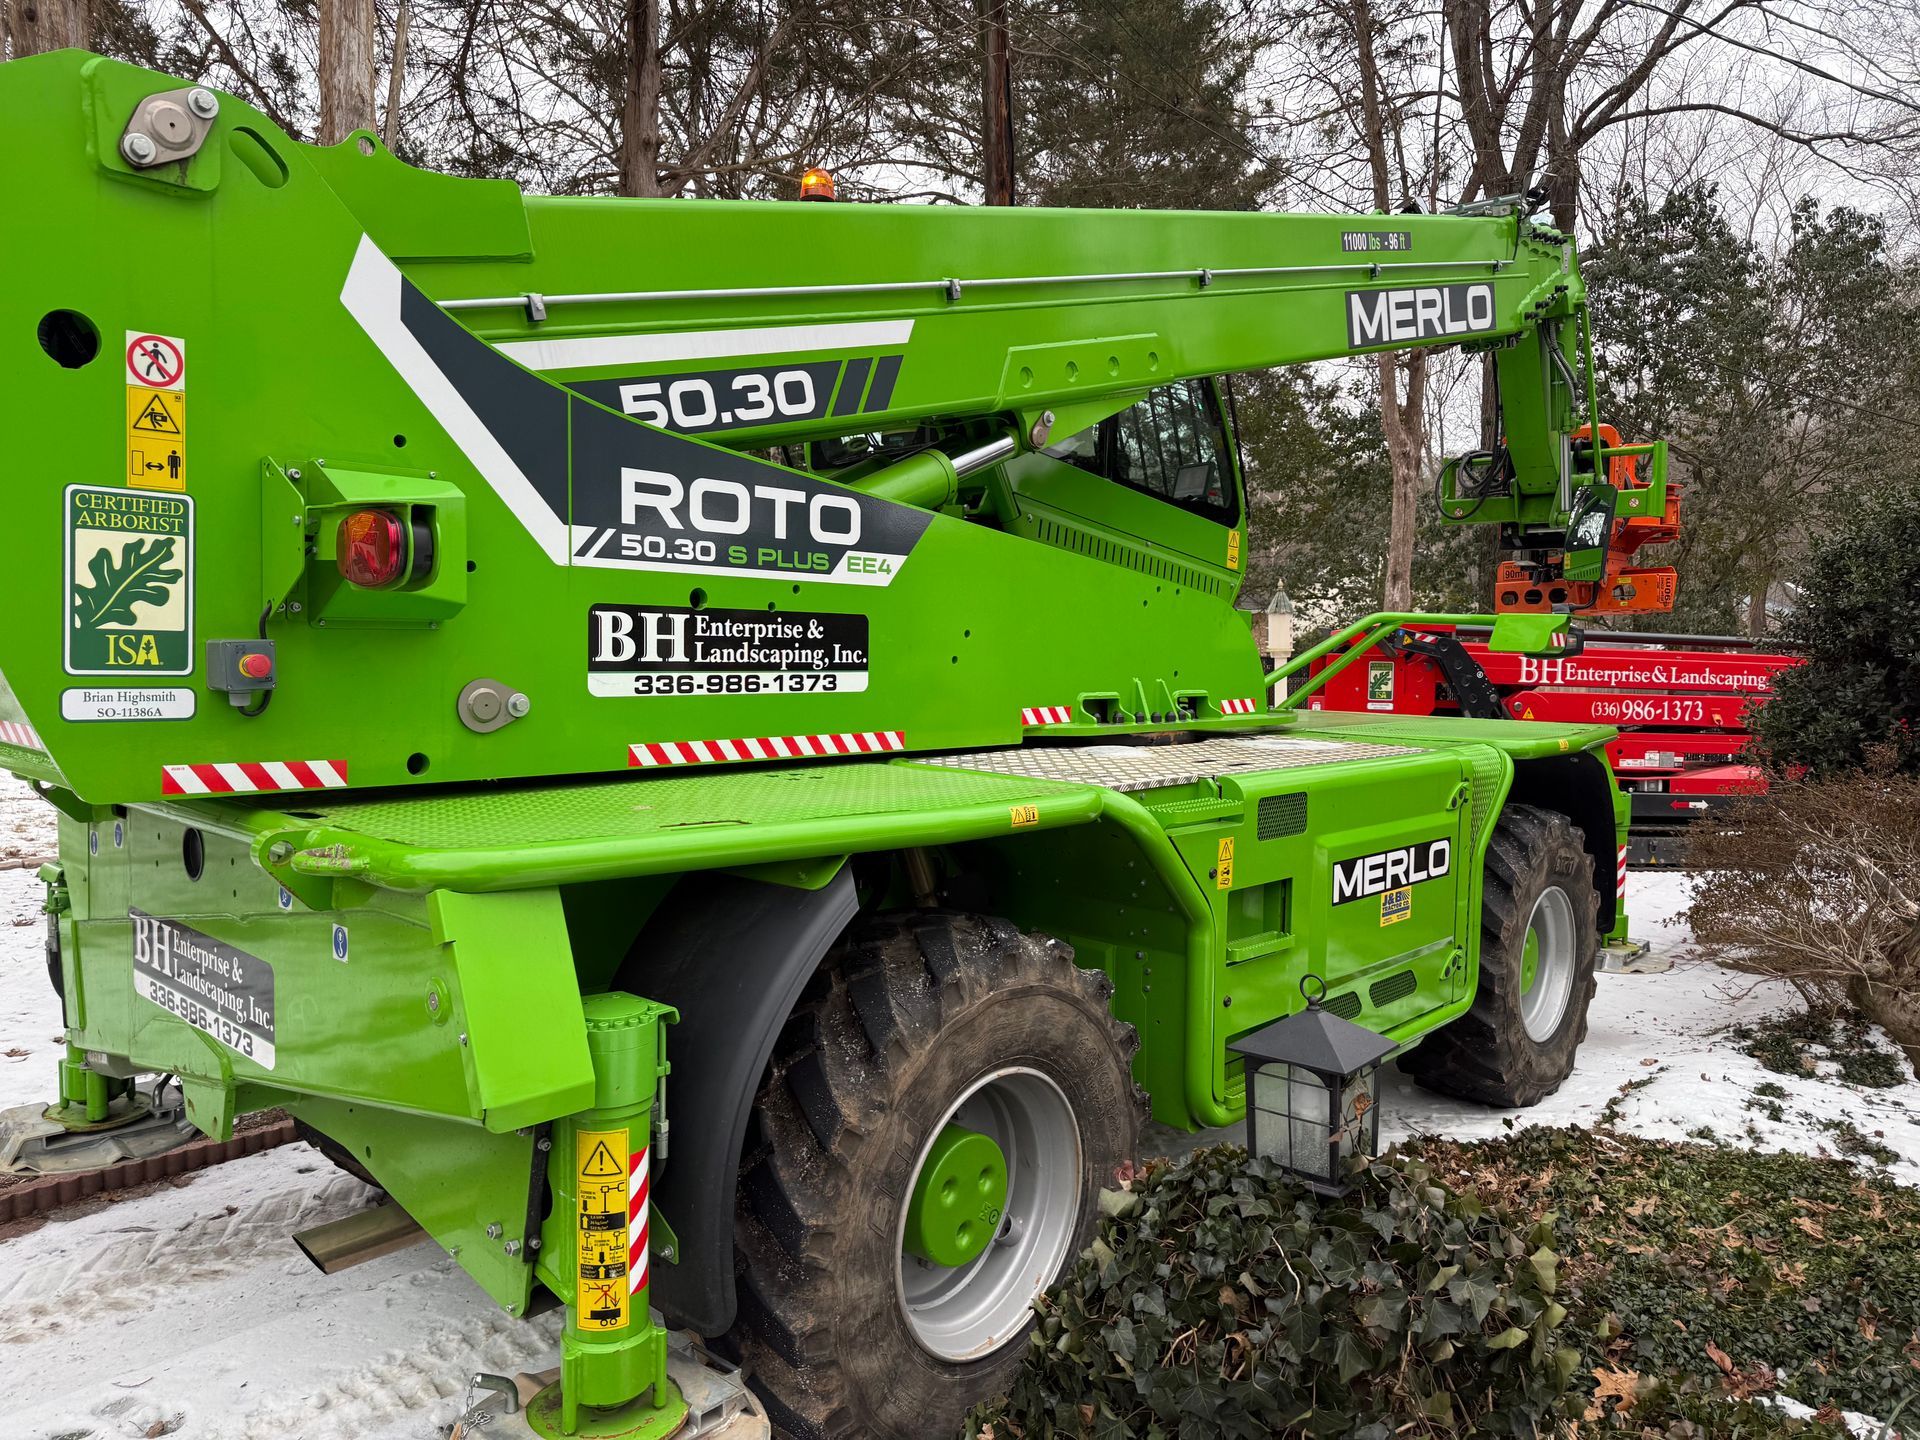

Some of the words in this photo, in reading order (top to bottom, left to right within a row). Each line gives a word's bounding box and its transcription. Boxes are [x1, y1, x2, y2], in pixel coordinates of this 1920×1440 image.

[1343, 233, 1367, 250] 11000
[1369, 233, 1381, 250] lbs
[1389, 233, 1399, 250] 96
[1399, 233, 1406, 250] ft
[1351, 284, 1492, 346] MERLO
[619, 370, 817, 430] 50.30
[75, 492, 184, 516] CERTIFIED
[620, 466, 861, 546] ROTO
[77, 511, 184, 533] ARBORIST
[620, 534, 717, 562] 50.30
[728, 545, 748, 565] S
[758, 549, 830, 571] PLUS
[846, 557, 893, 576] EE4
[105, 634, 160, 665] ISA
[592, 610, 690, 663] BH
[694, 615, 803, 645] Enterprise
[806, 619, 824, 639] &
[694, 641, 829, 671] Landscaping,
[833, 644, 868, 664] Inc.
[1518, 656, 1565, 684] BH
[1565, 662, 1650, 685] Enterprise
[1651, 666, 1668, 683] &
[82, 690, 114, 703] Brian
[117, 691, 177, 708] Highsmith
[634, 673, 837, 695] 336-986-1373
[96, 707, 163, 718] SO-11386A
[1591, 702, 1620, 719] (336)
[1622, 700, 1703, 721] 986-1373
[1333, 839, 1450, 904] MERLO
[129, 913, 173, 978] BH
[173, 929, 230, 978] Enterprise
[231, 957, 244, 984] &
[173, 958, 248, 1024] Landscaping,
[249, 995, 274, 1032] Inc.
[149, 980, 254, 1057] 336-986-1373
